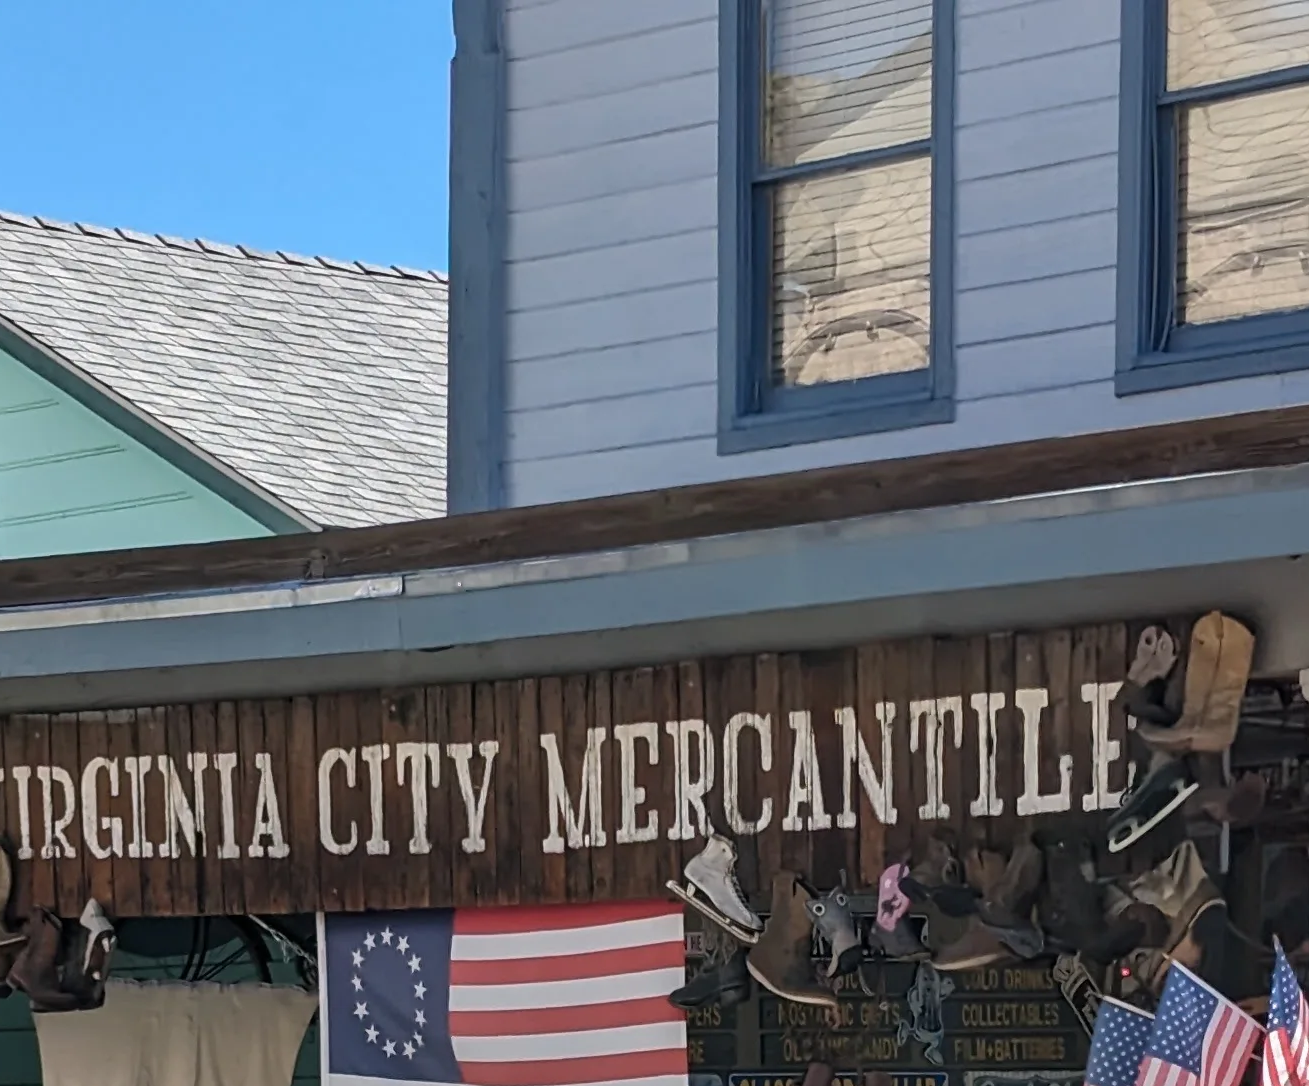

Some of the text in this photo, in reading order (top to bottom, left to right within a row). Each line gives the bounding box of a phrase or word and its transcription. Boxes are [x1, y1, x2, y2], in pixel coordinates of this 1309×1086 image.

[317, 738, 499, 857] CITY
[539, 682, 1138, 857] MERCANTILE
[1003, 967, 1054, 990] DRINKS
[961, 1003, 1060, 1027] COLLECTABLES
